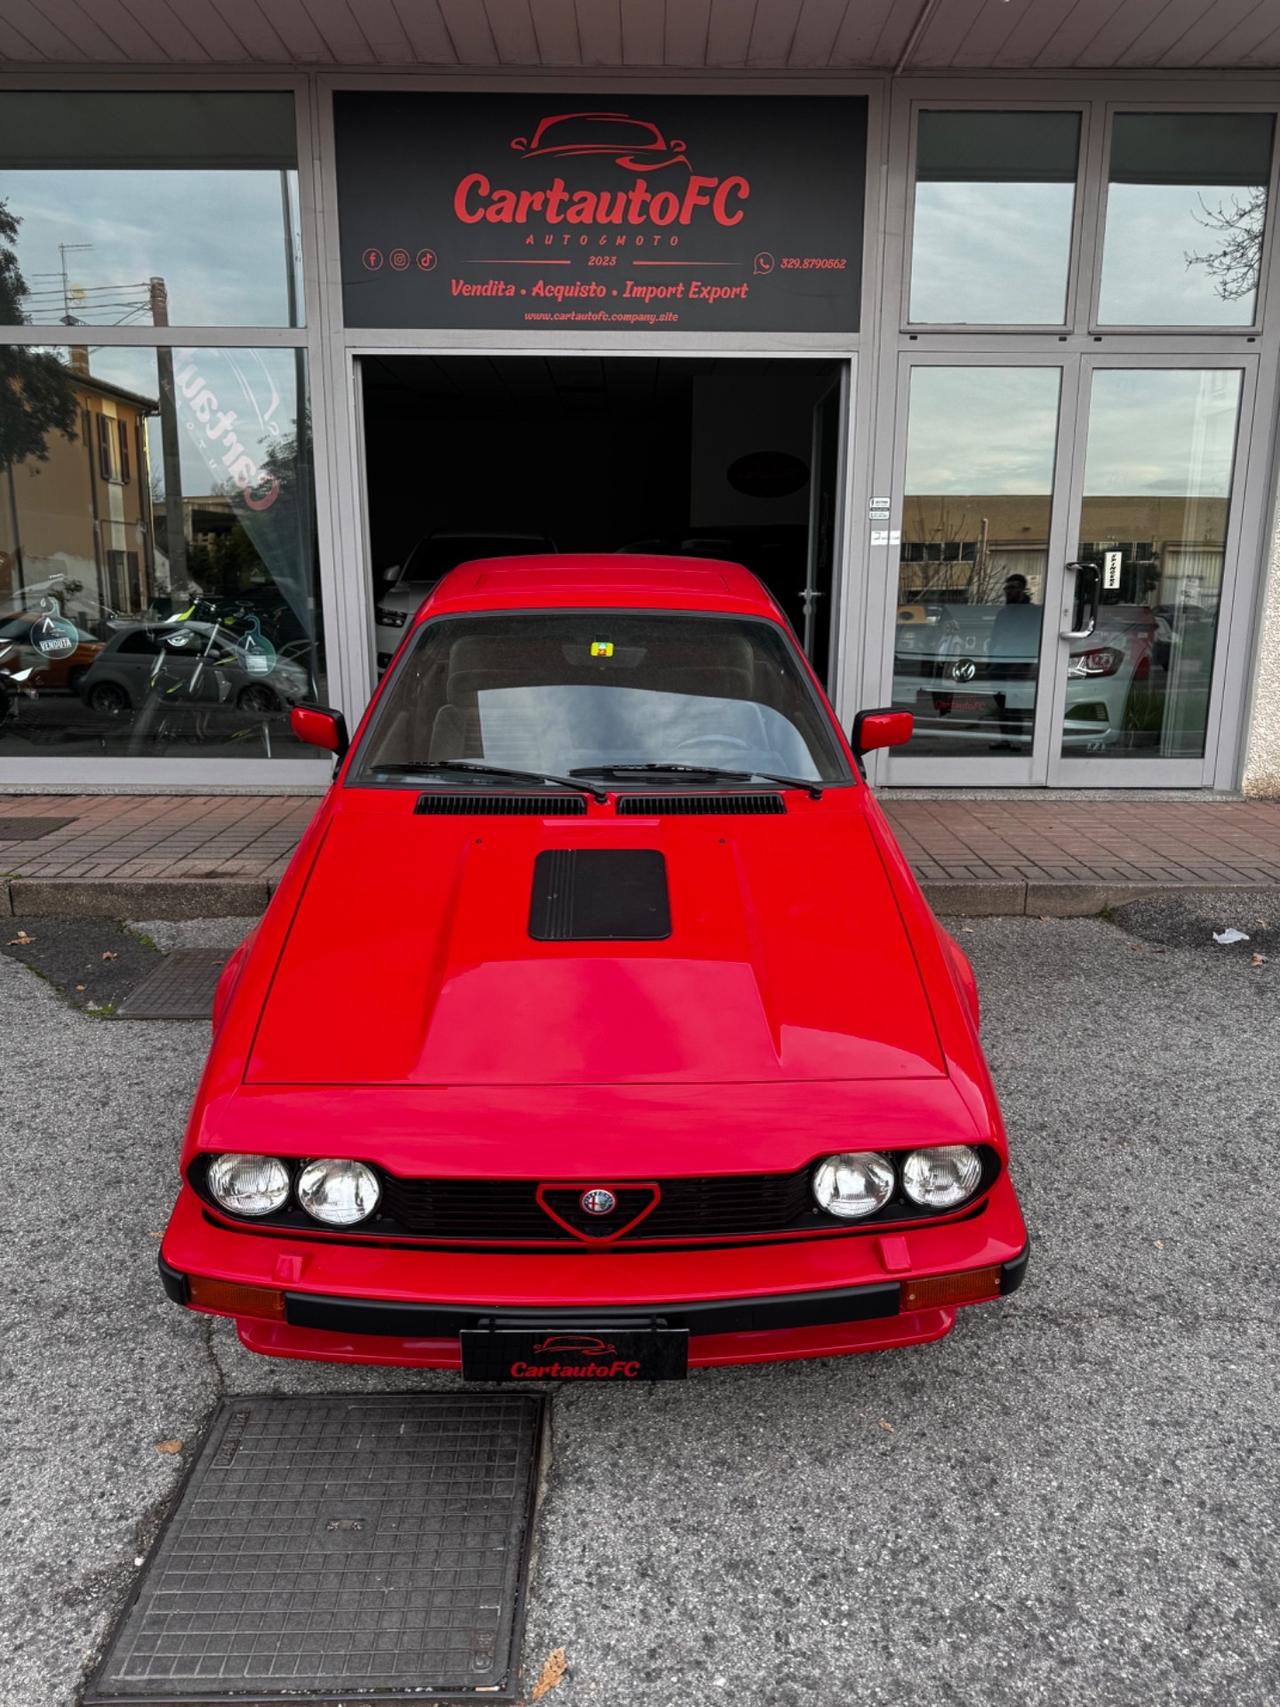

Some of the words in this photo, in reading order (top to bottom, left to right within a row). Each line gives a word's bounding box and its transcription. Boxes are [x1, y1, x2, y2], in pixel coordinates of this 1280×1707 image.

[453, 173, 750, 226] CartautoFC
[587, 255, 617, 266] 2023
[450, 279, 516, 297] Vendita
[531, 279, 607, 302] Acquisto
[622, 280, 684, 303] Import
[688, 281, 749, 304] Export
[510, 1361, 640, 1378] CartautoFC
